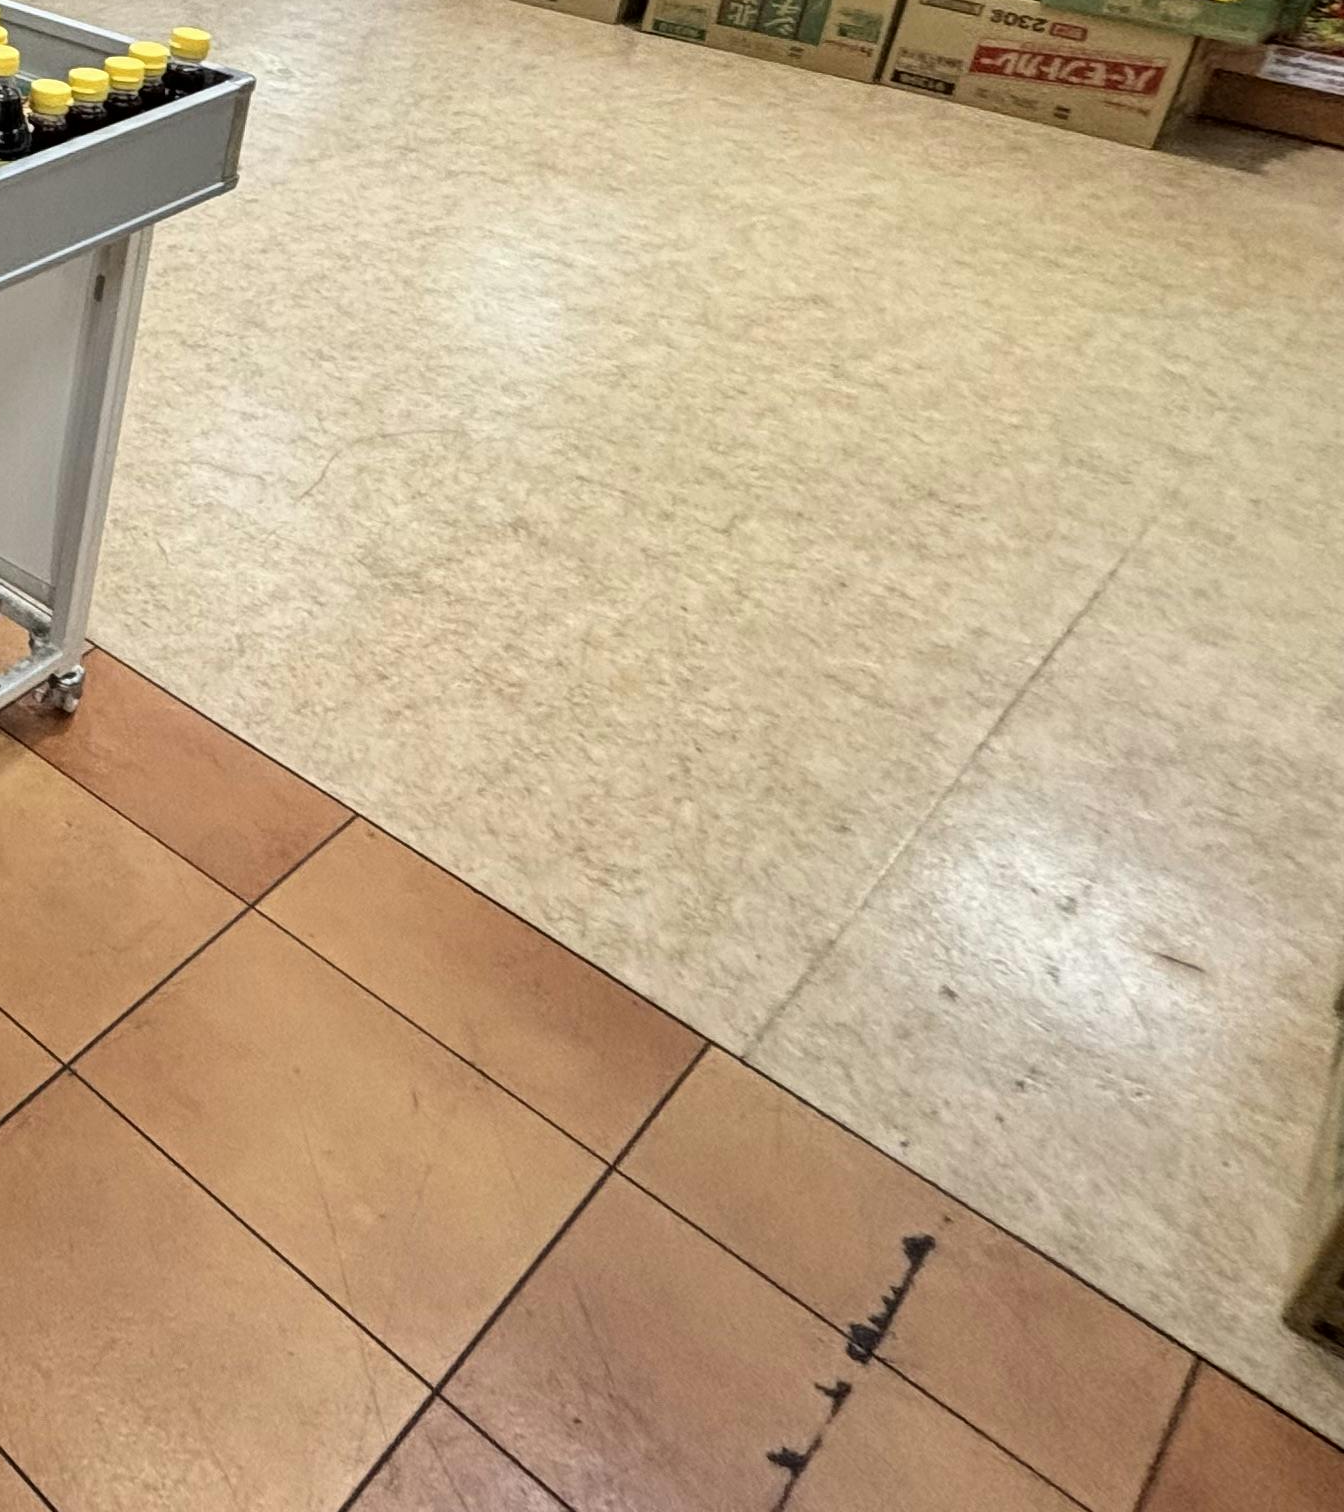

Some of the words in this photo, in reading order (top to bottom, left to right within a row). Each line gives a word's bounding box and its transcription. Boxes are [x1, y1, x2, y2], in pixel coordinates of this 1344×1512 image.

[979, 51, 1156, 92] バーモントカレー
